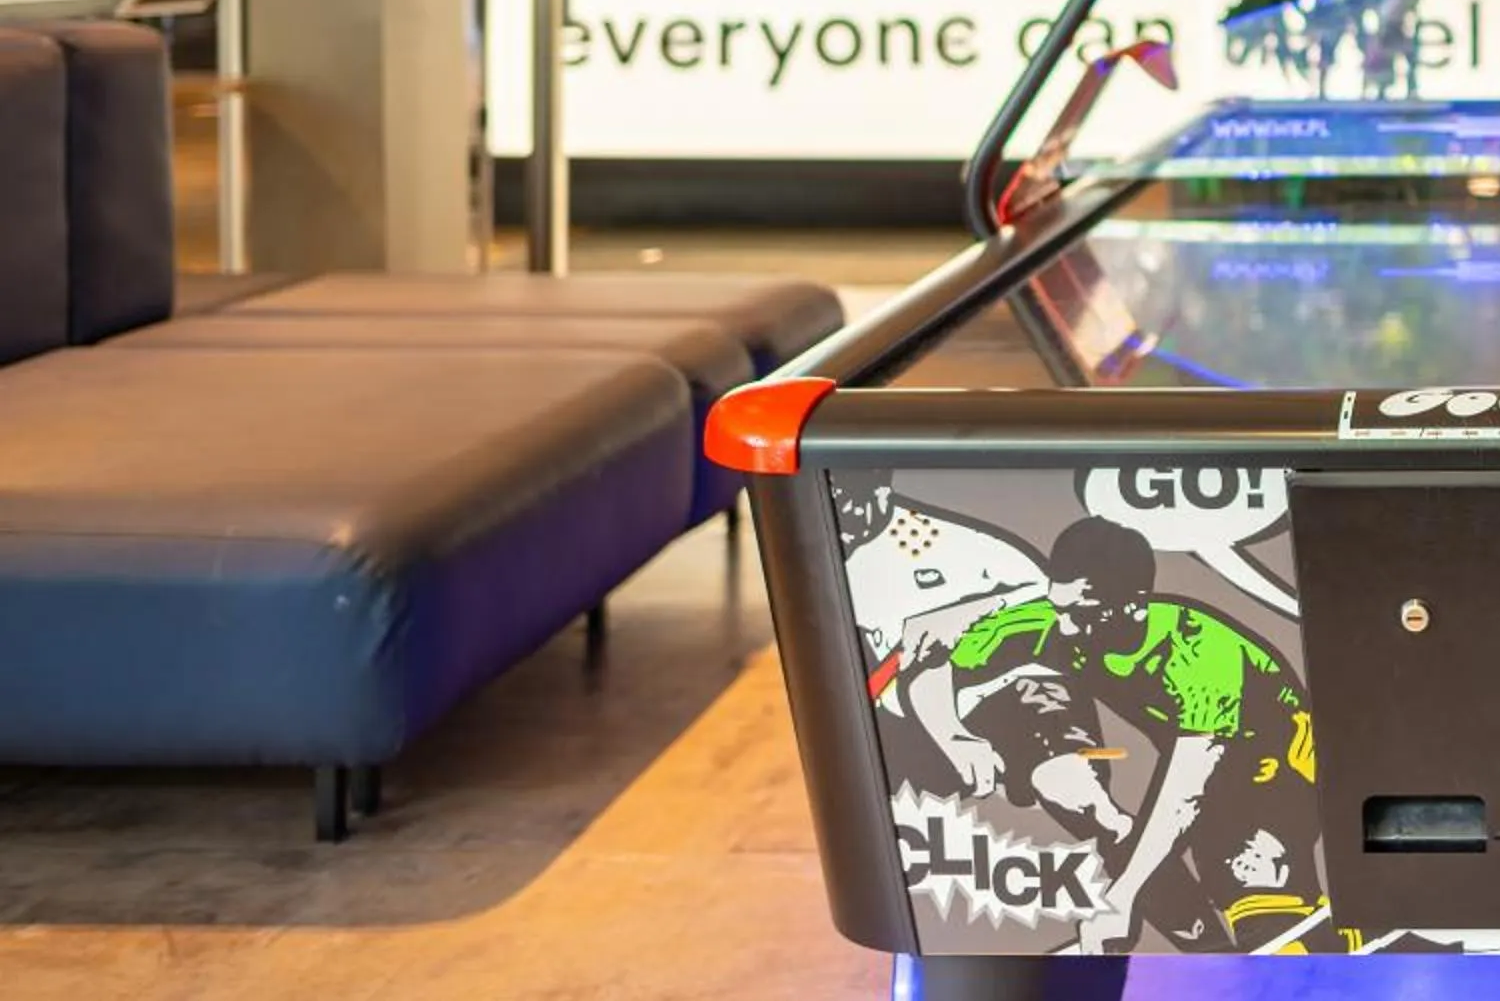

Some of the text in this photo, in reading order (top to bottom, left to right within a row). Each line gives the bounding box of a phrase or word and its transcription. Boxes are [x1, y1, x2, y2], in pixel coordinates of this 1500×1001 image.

[562, 15, 980, 89] everyone
[1117, 467, 1265, 510] GO!
[895, 816, 1094, 908] CLICK
